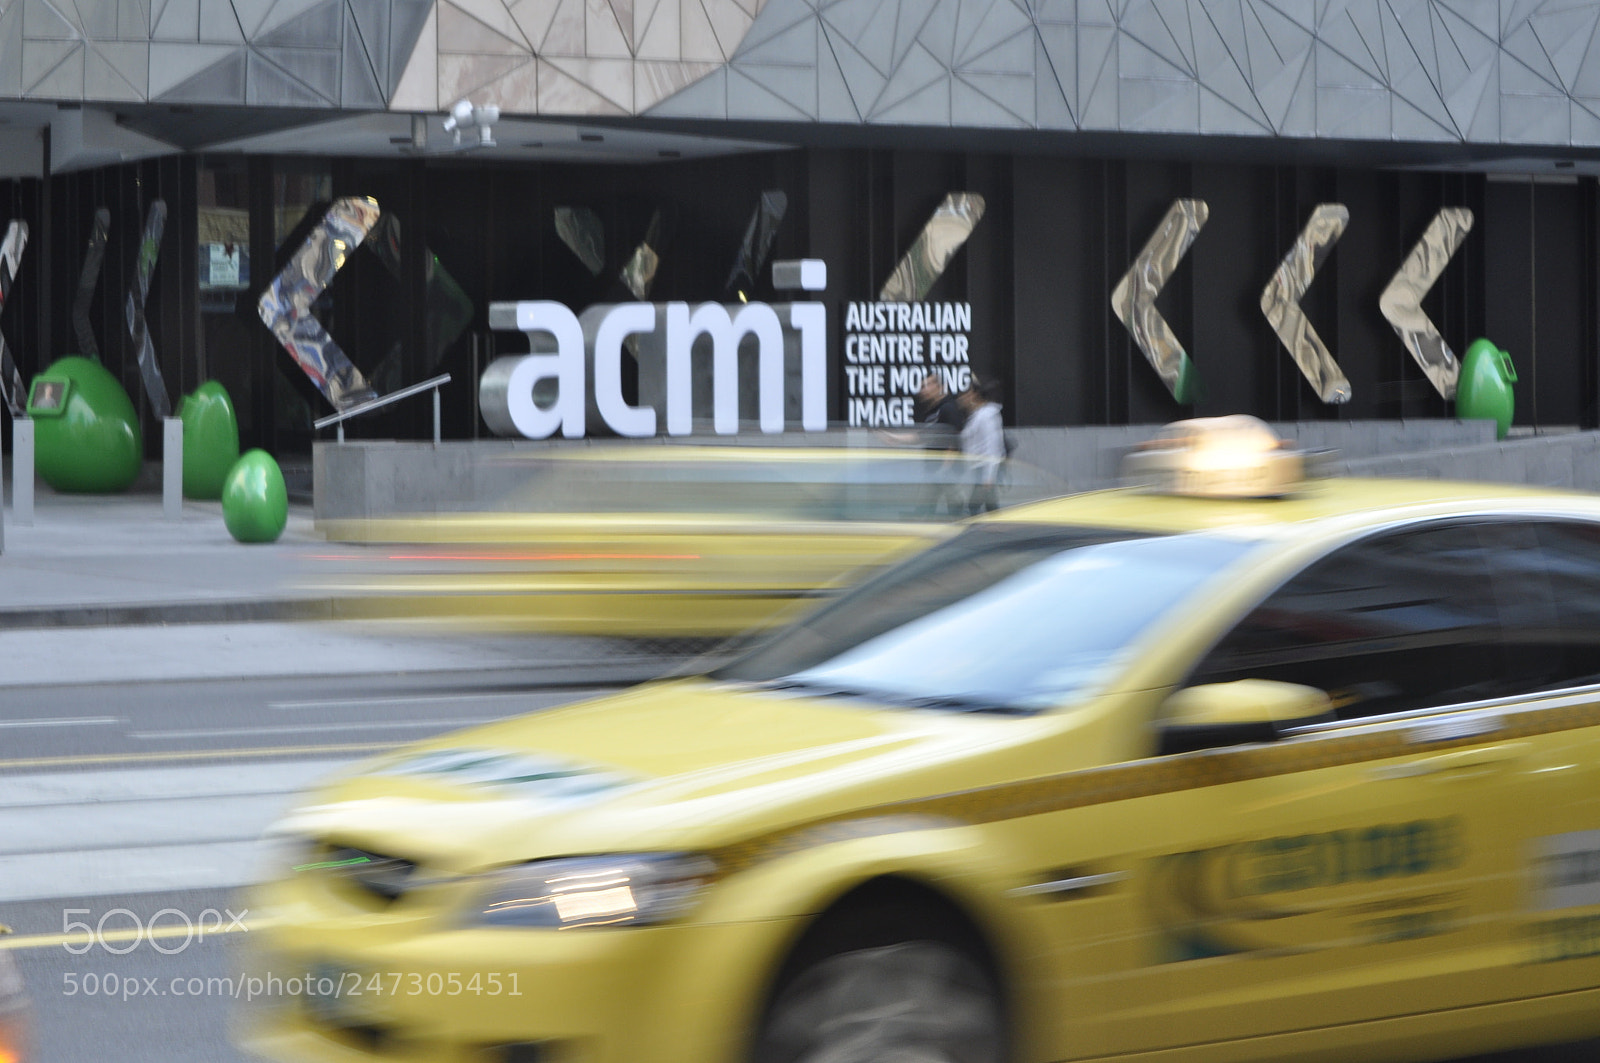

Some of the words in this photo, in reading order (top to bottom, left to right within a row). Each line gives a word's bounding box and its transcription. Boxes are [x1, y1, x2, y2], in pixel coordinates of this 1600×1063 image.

[846, 301, 972, 332] AUSTRALIAN
[506, 258, 828, 440] acmi
[846, 333, 924, 364] CENTRE
[930, 333, 970, 364] FOR
[845, 365, 886, 396] THE
[848, 397, 915, 427] IMAGE
